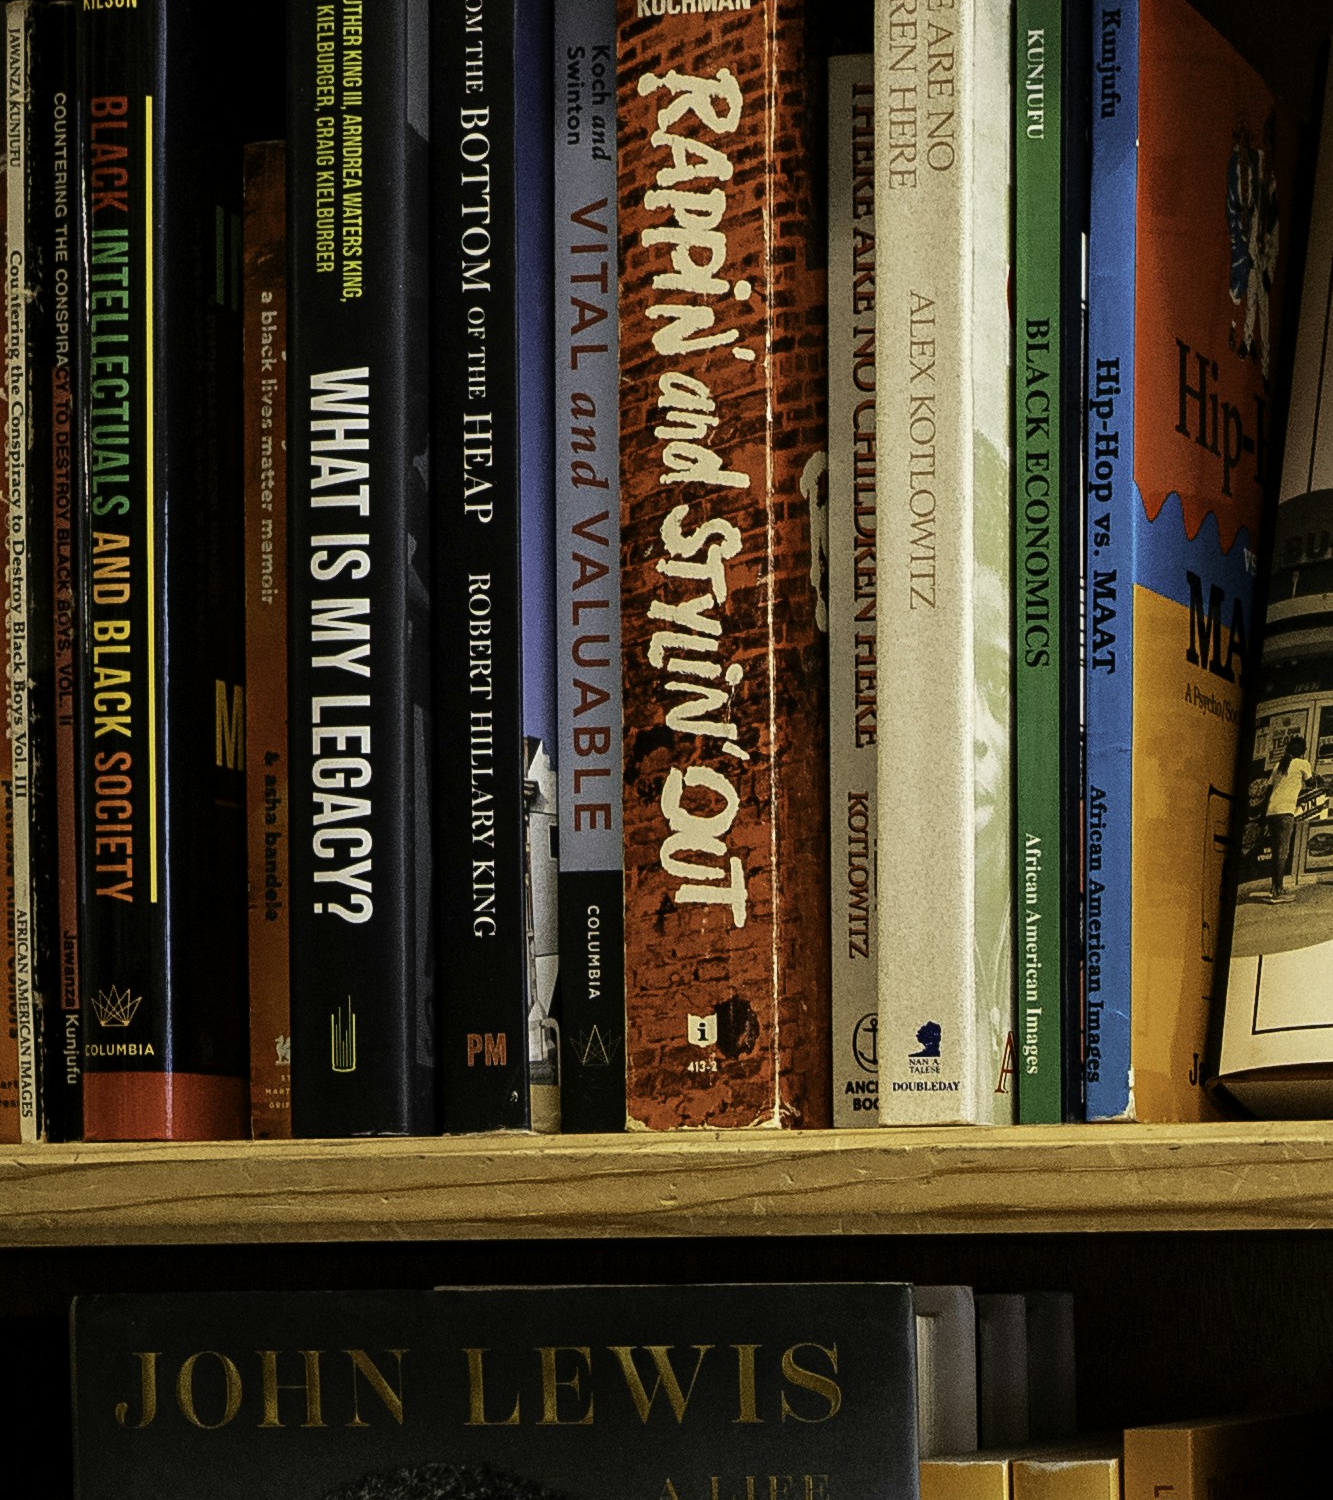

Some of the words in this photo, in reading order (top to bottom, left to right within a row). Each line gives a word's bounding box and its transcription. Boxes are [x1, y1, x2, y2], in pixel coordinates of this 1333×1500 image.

[1026, 28, 1046, 141] KUNJUFU
[1026, 319, 1049, 439] BLACK
[310, 367, 369, 516] WHAT
[310, 534, 371, 580] IS
[1026, 452, 1049, 667] ECONOMICS
[311, 598, 370, 677] MY
[312, 695, 373, 923] LEGACY?
[85, 1043, 155, 1056] COLUMBIA
[115, 1350, 406, 1429] JOHN
[465, 1343, 842, 1425] LEWIS
